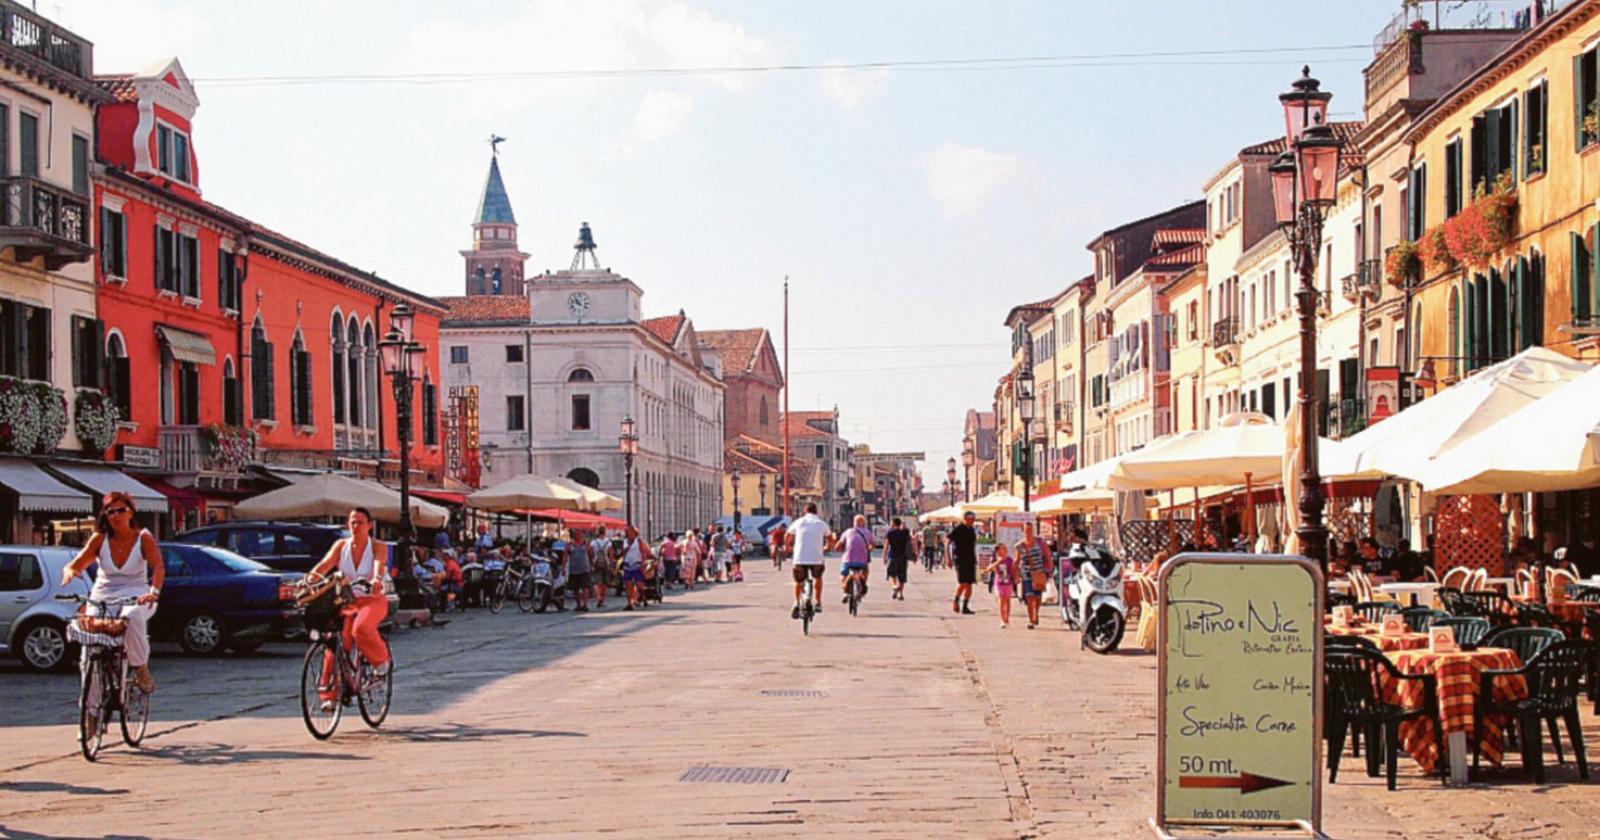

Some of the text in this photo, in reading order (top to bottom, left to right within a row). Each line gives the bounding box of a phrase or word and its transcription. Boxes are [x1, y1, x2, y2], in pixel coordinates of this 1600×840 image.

[468, 386, 478, 448] ANTICO
[1247, 599, 1299, 633] Nic
[1256, 714, 1296, 733] Carne
[1179, 756, 1238, 774] 50 mt.
[1193, 808, 1214, 820] Info
[1216, 809, 1236, 820] 041
